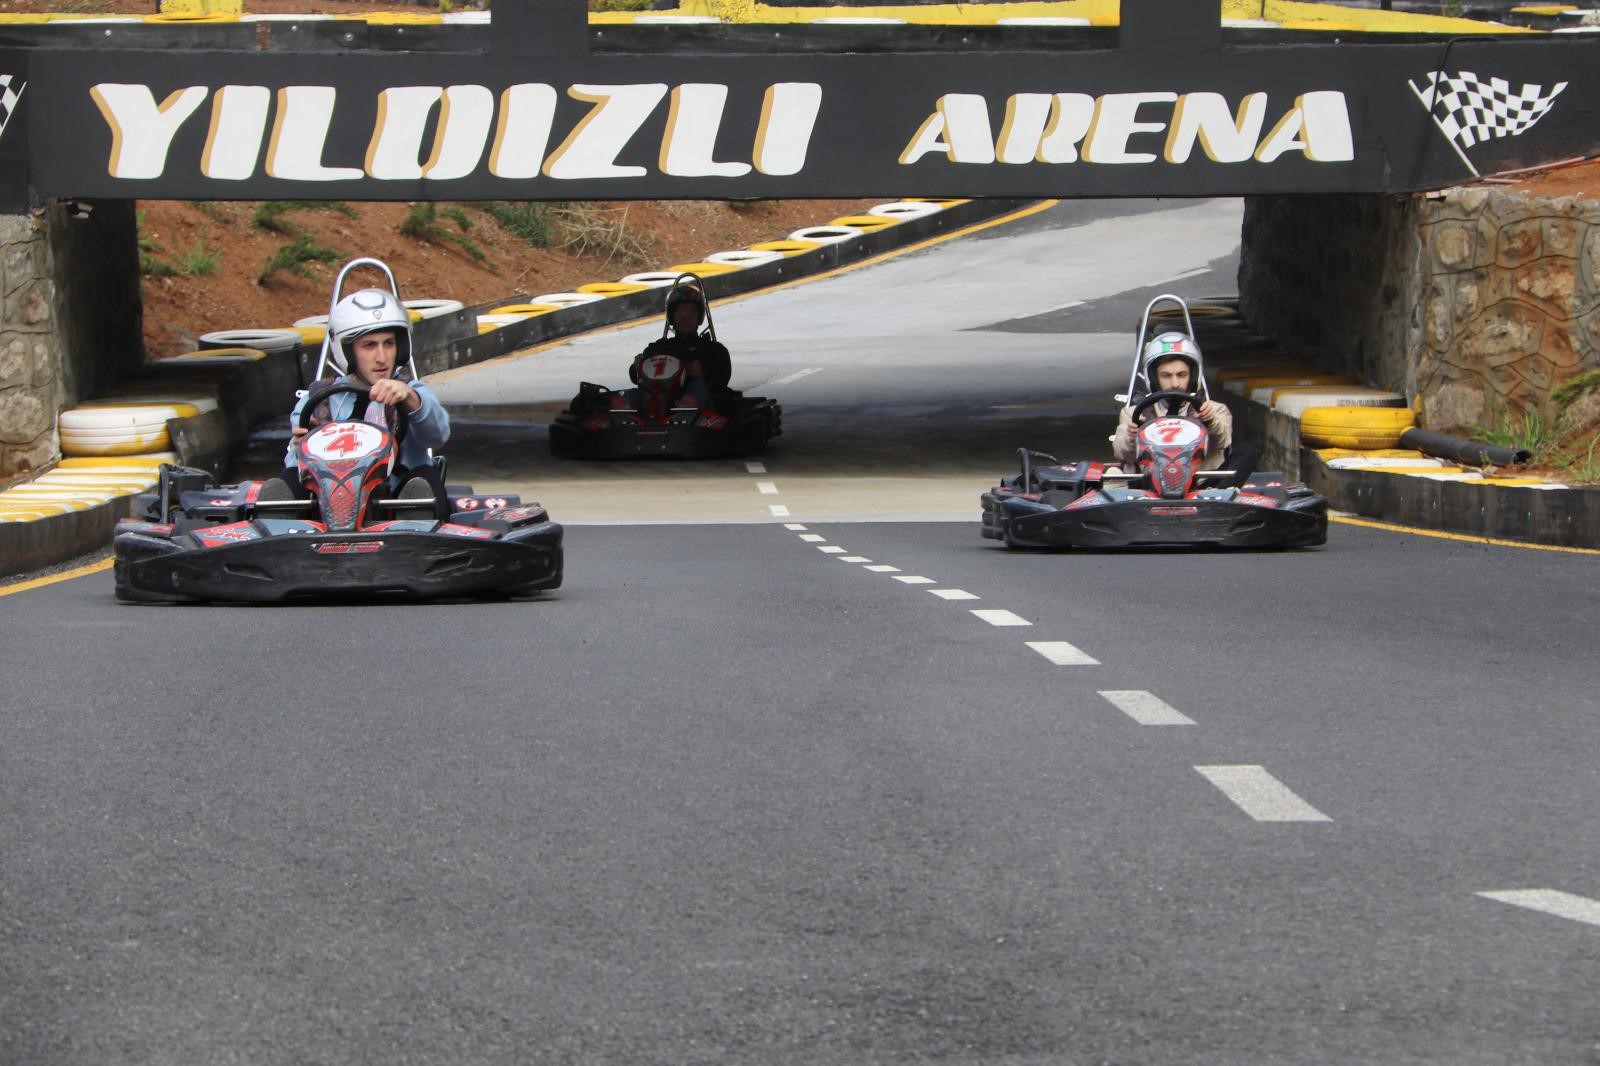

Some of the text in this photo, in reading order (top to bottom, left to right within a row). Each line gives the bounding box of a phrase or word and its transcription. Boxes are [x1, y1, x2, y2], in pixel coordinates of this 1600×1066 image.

[89, 82, 1355, 180] YILDIZLI ARENA
[324, 433, 362, 457] 4
[1159, 427, 1182, 443] 7
